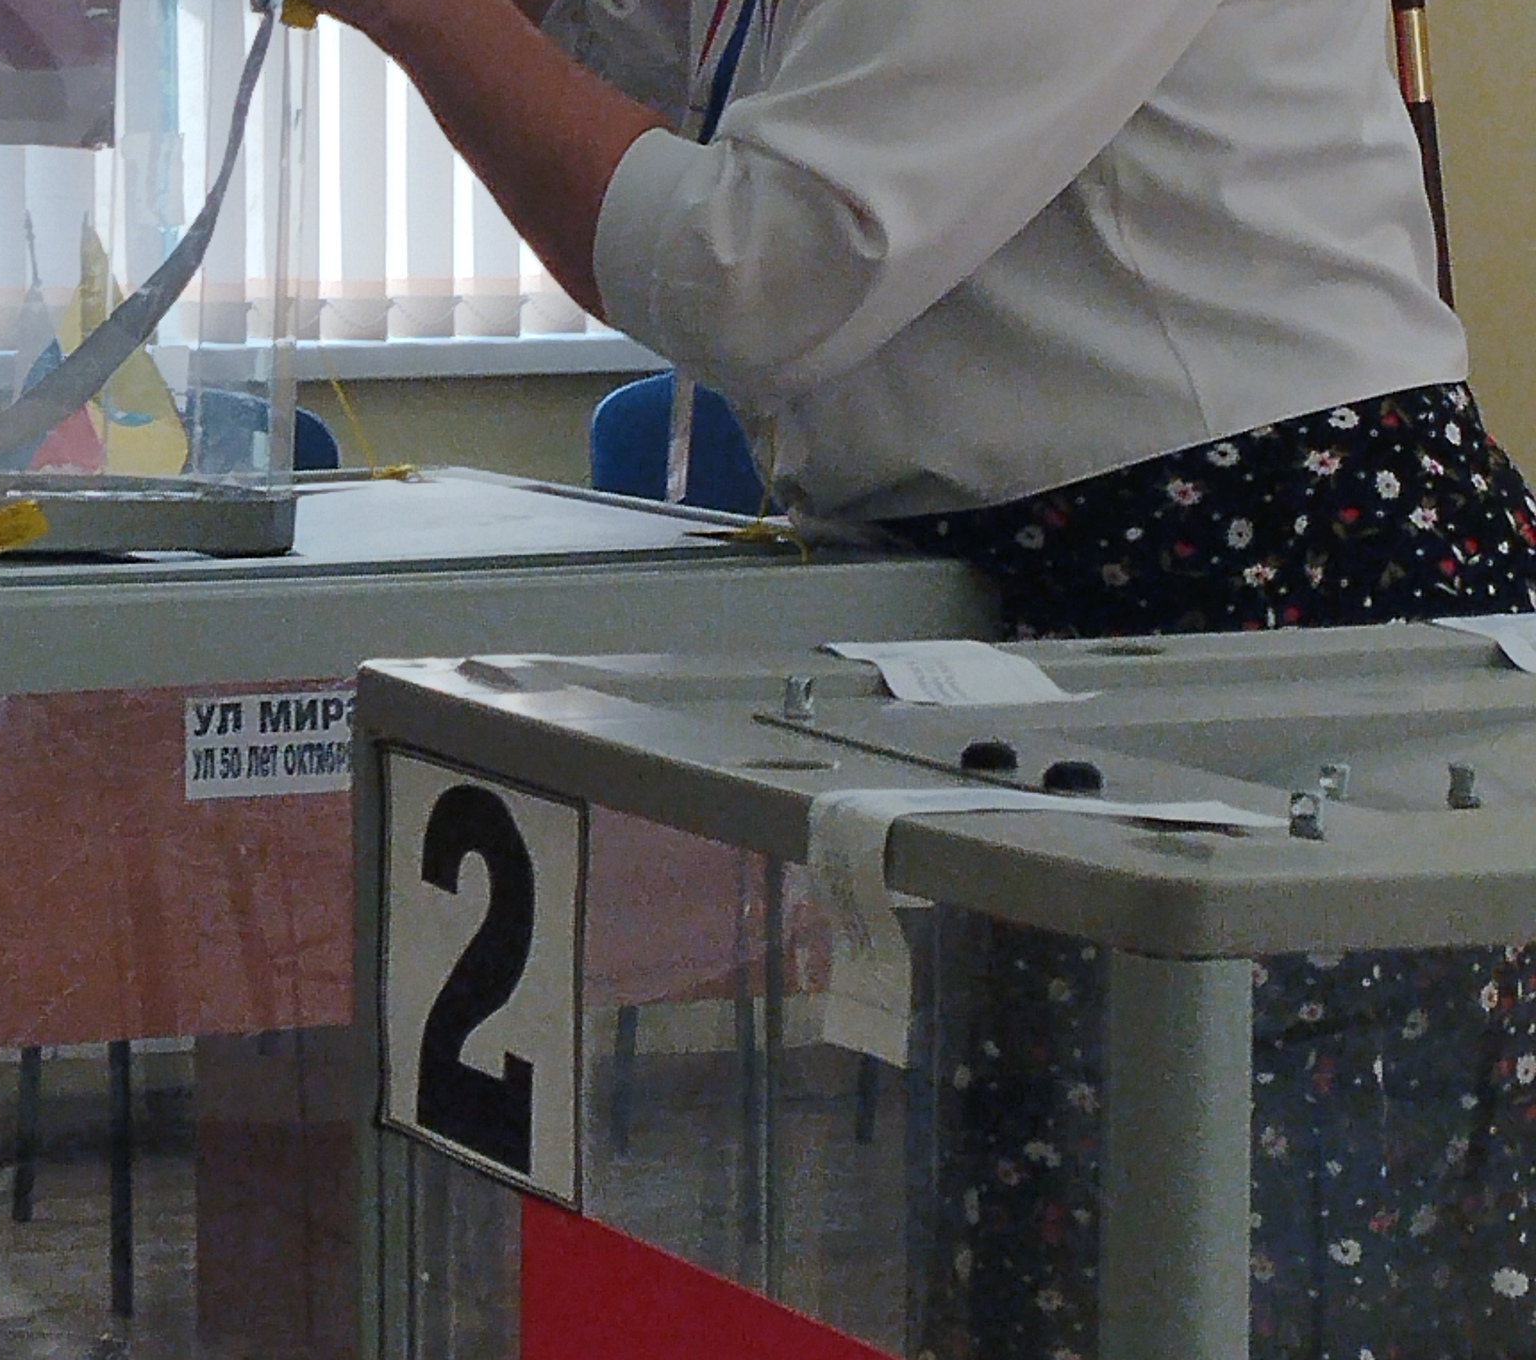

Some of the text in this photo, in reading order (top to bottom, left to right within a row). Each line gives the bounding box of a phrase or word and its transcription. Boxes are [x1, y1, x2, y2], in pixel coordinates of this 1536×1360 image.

[219, 746, 242, 779] 50
[284, 741, 352, 776] ОКТЯБР
[417, 783, 535, 1177] 2
